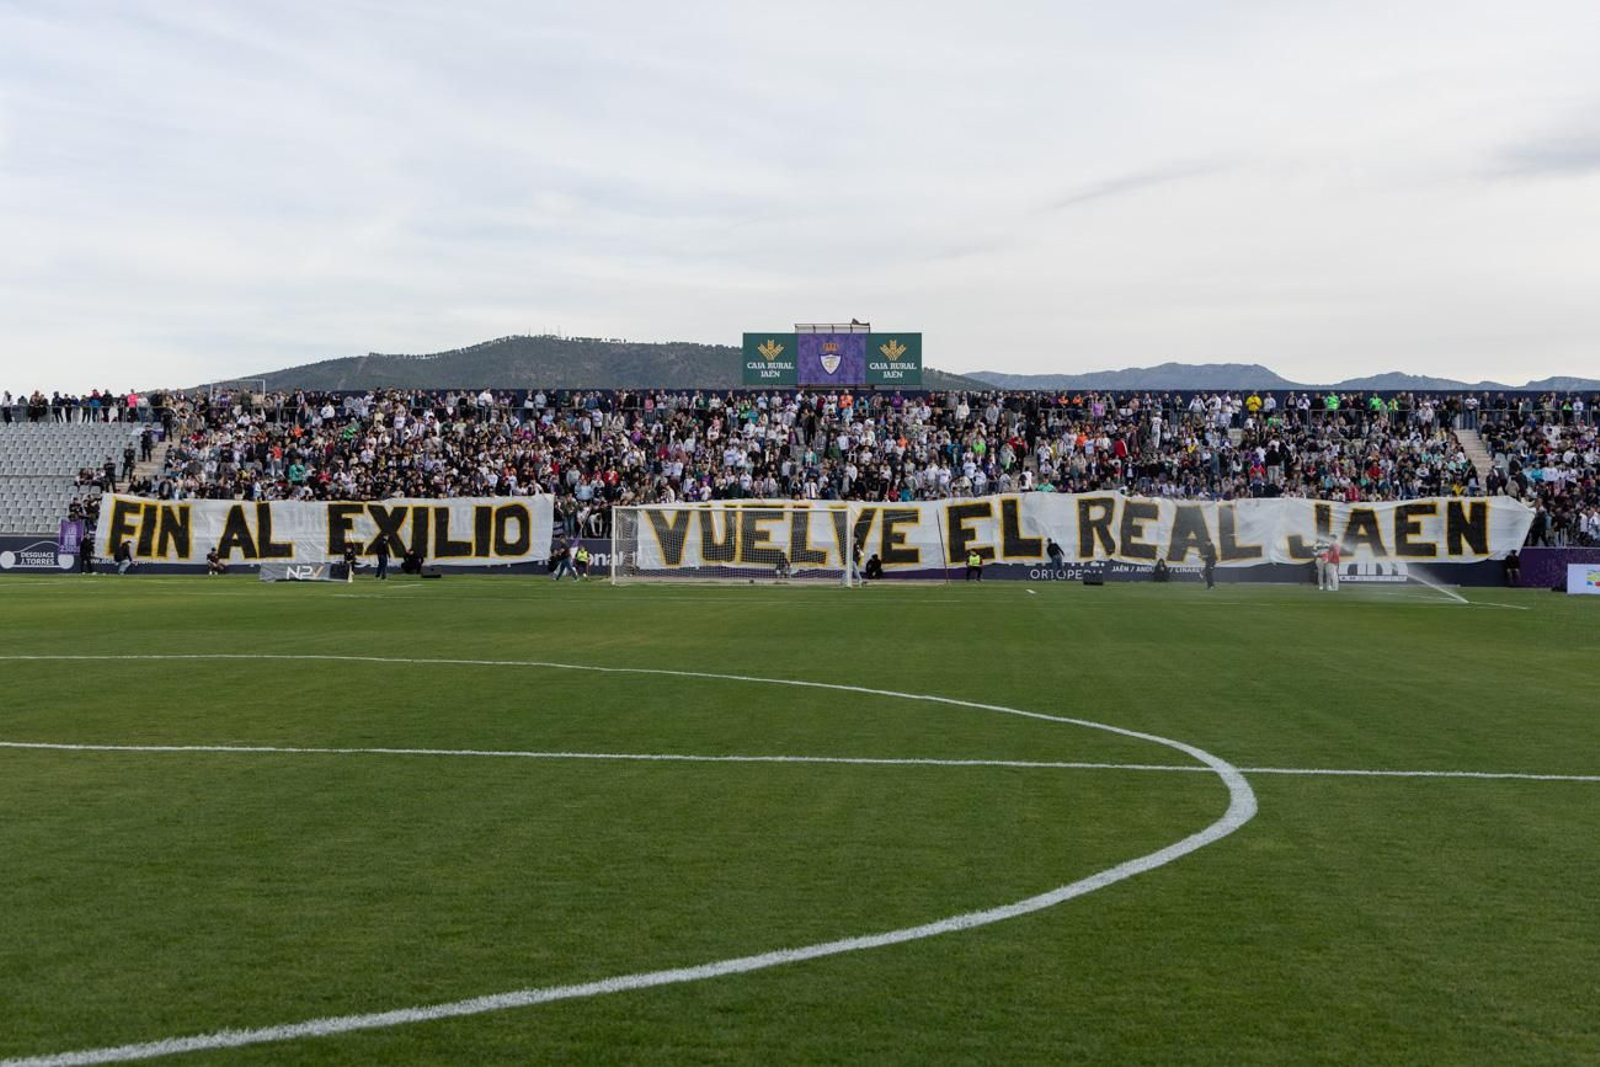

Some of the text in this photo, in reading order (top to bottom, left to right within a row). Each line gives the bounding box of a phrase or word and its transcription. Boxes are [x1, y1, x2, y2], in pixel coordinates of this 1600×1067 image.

[767, 362, 794, 370] RURAL
[890, 362, 917, 370] RURAL
[107, 496, 530, 561] FIN AL EXILIO
[645, 496, 1490, 567] VUELVE EL REAL JAEN
[1030, 569, 1103, 579] ORTOPE
